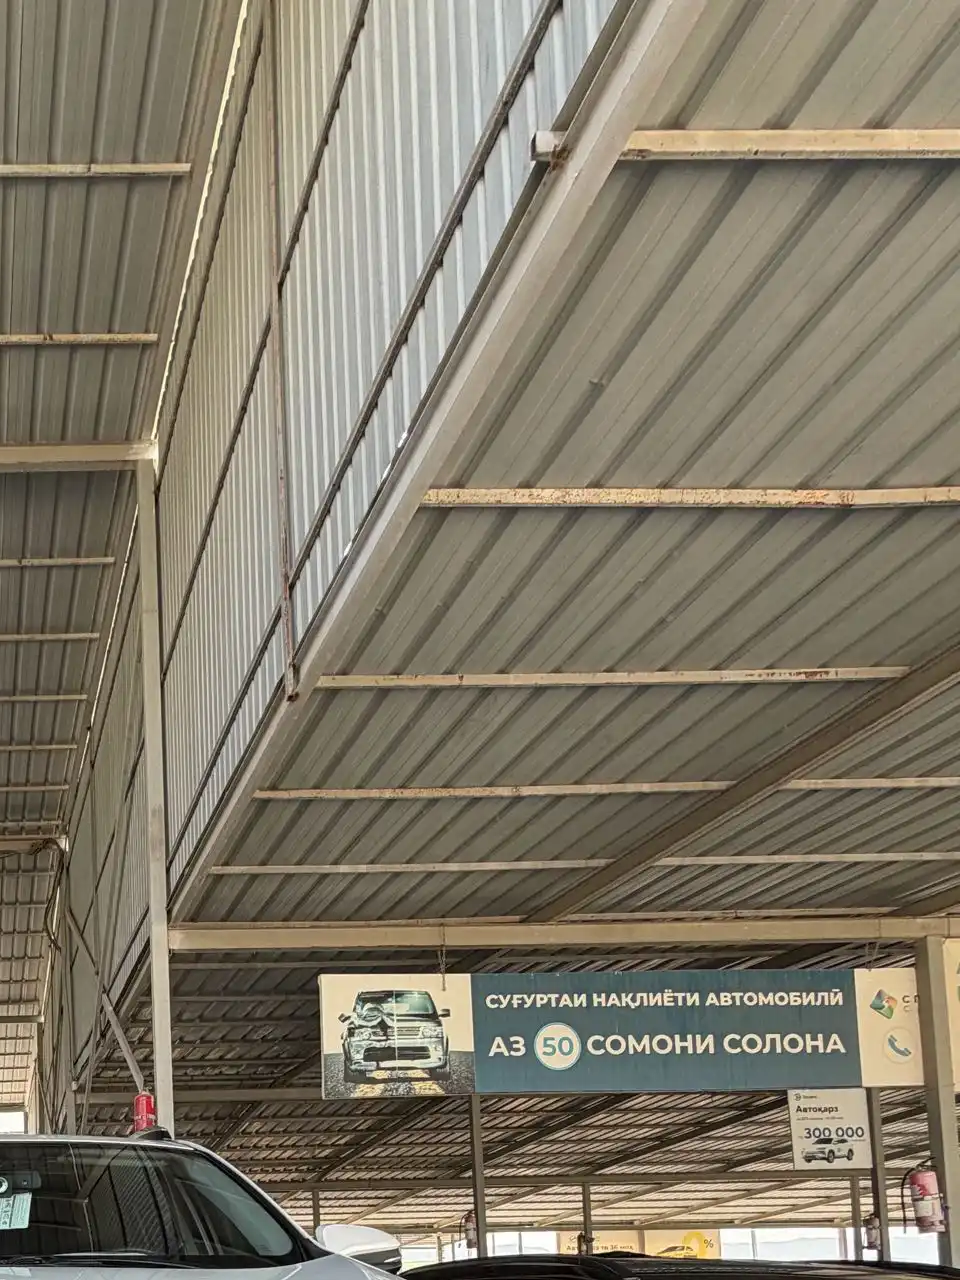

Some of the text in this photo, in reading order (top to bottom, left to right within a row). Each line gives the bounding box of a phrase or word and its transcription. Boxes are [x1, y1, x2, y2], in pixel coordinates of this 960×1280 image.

[485, 988, 844, 1009] СУҒУРТАИ НАҚЛИЁТИ АВТОМОБИЛӢ
[488, 1033, 847, 1057] АЗ 50 СОМОНИ СОЛОНА
[803, 1127, 832, 1139] 300
[835, 1126, 865, 1138] 000
